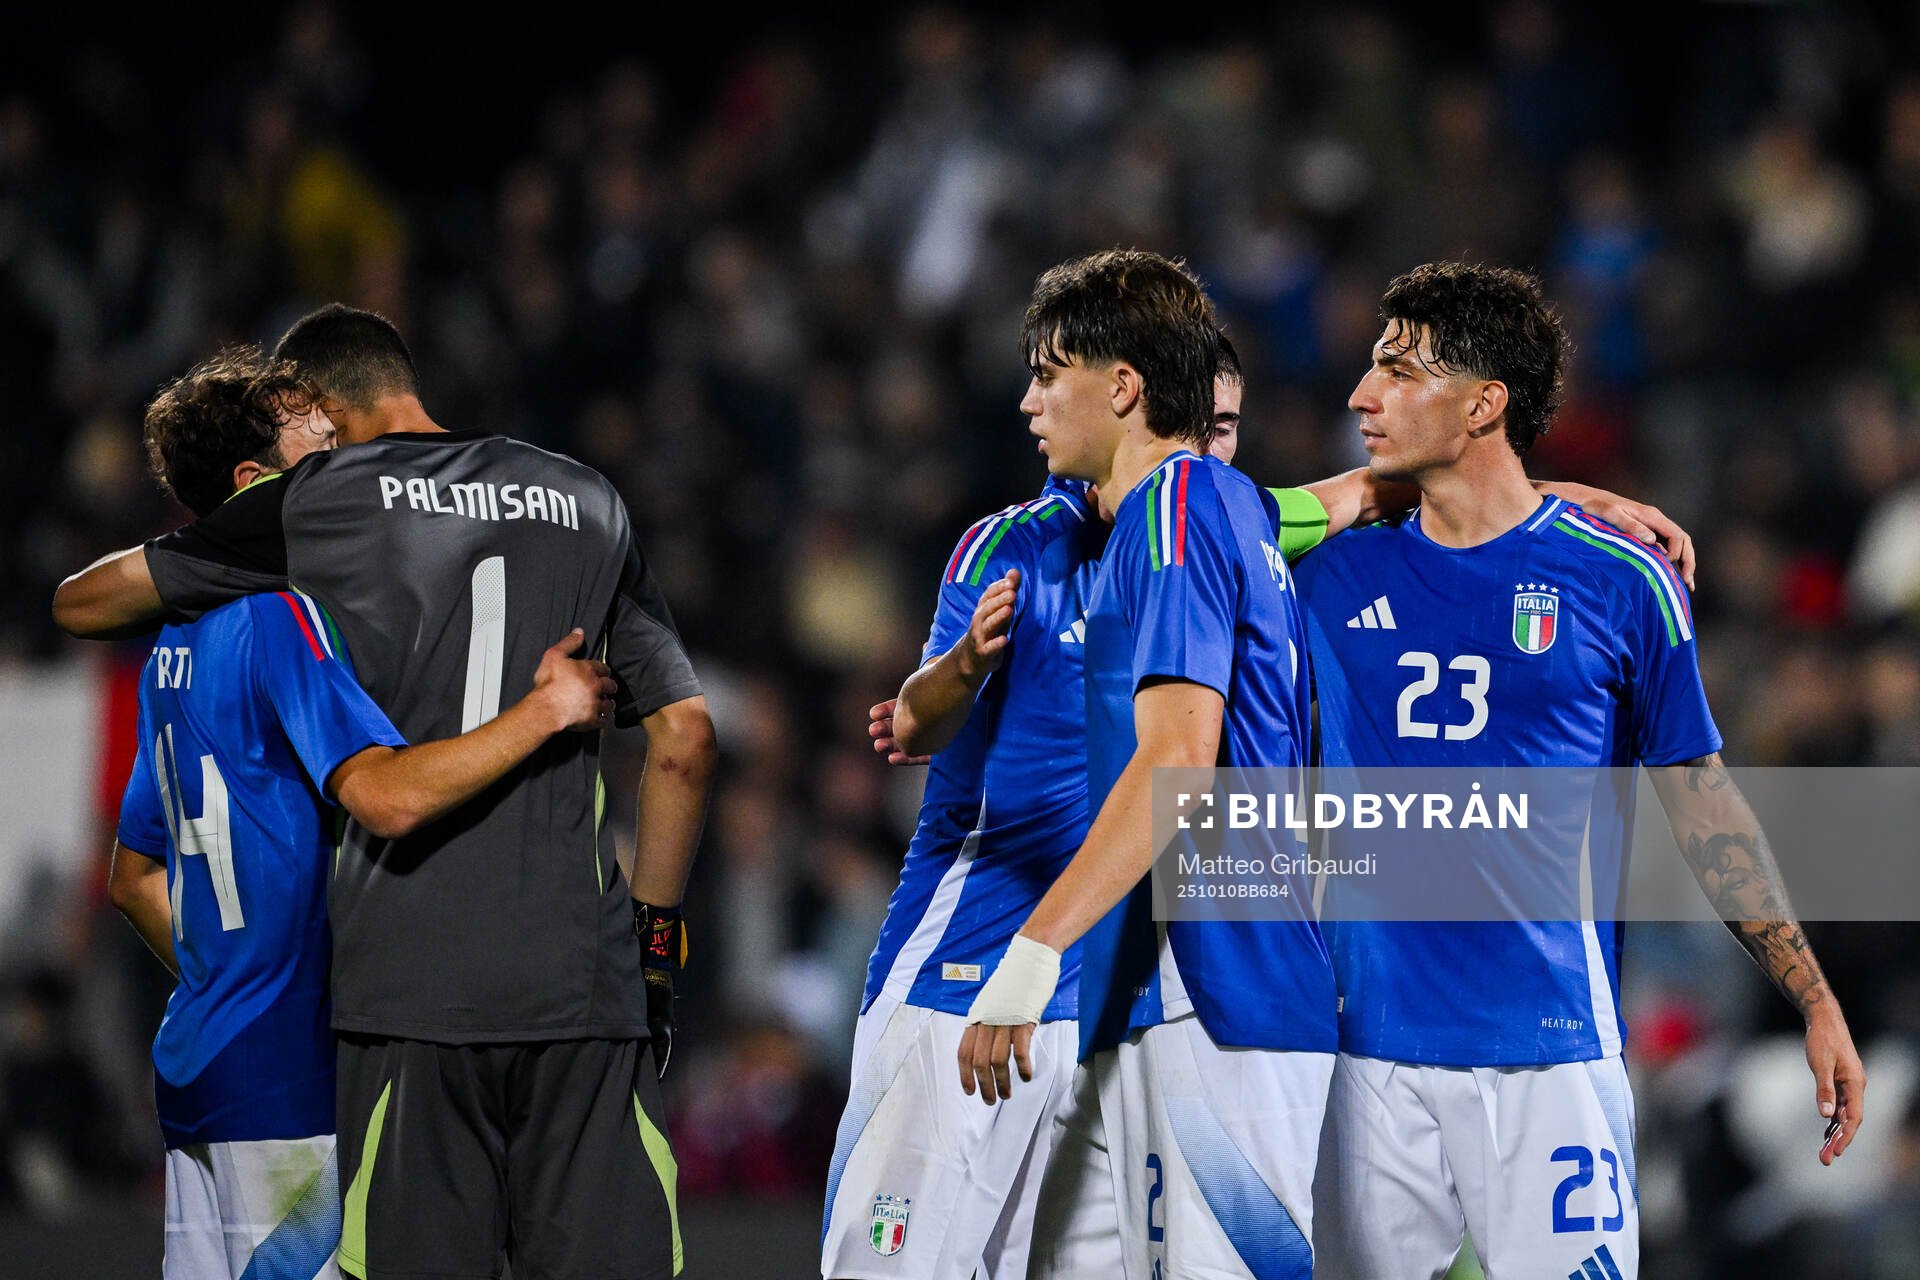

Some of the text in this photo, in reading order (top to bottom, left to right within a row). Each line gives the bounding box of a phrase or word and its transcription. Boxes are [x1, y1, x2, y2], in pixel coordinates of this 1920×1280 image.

[379, 476, 579, 531] PALMISANI
[461, 556, 506, 736] 1
[1518, 598, 1554, 611] ITALIA
[152, 647, 192, 690] RTI
[1397, 651, 1491, 741] 23
[155, 723, 245, 942] 14
[1550, 1145, 1624, 1233] 23
